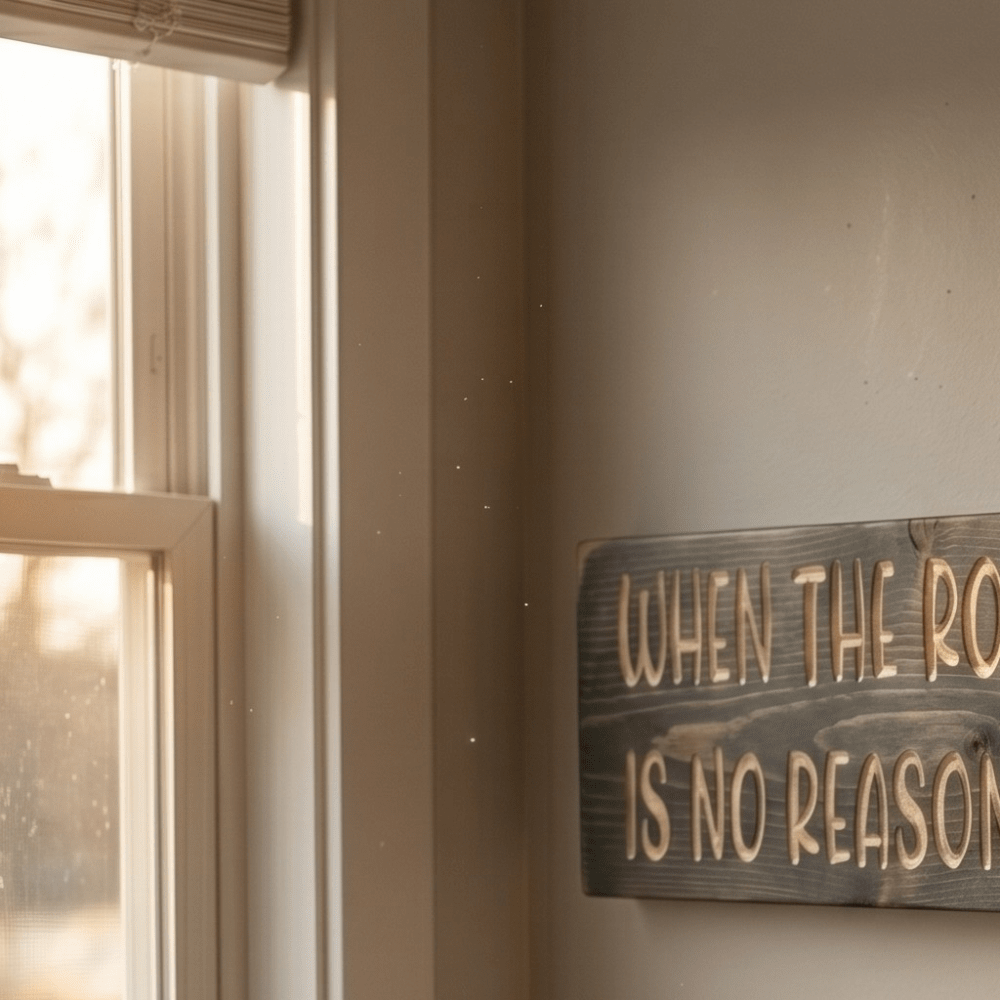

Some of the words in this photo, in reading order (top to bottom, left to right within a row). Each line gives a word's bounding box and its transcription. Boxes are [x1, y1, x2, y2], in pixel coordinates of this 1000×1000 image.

[618, 560, 772, 688] WHEN
[793, 557, 897, 688] THE
[624, 748, 670, 863] IS
[692, 746, 766, 863] NO
